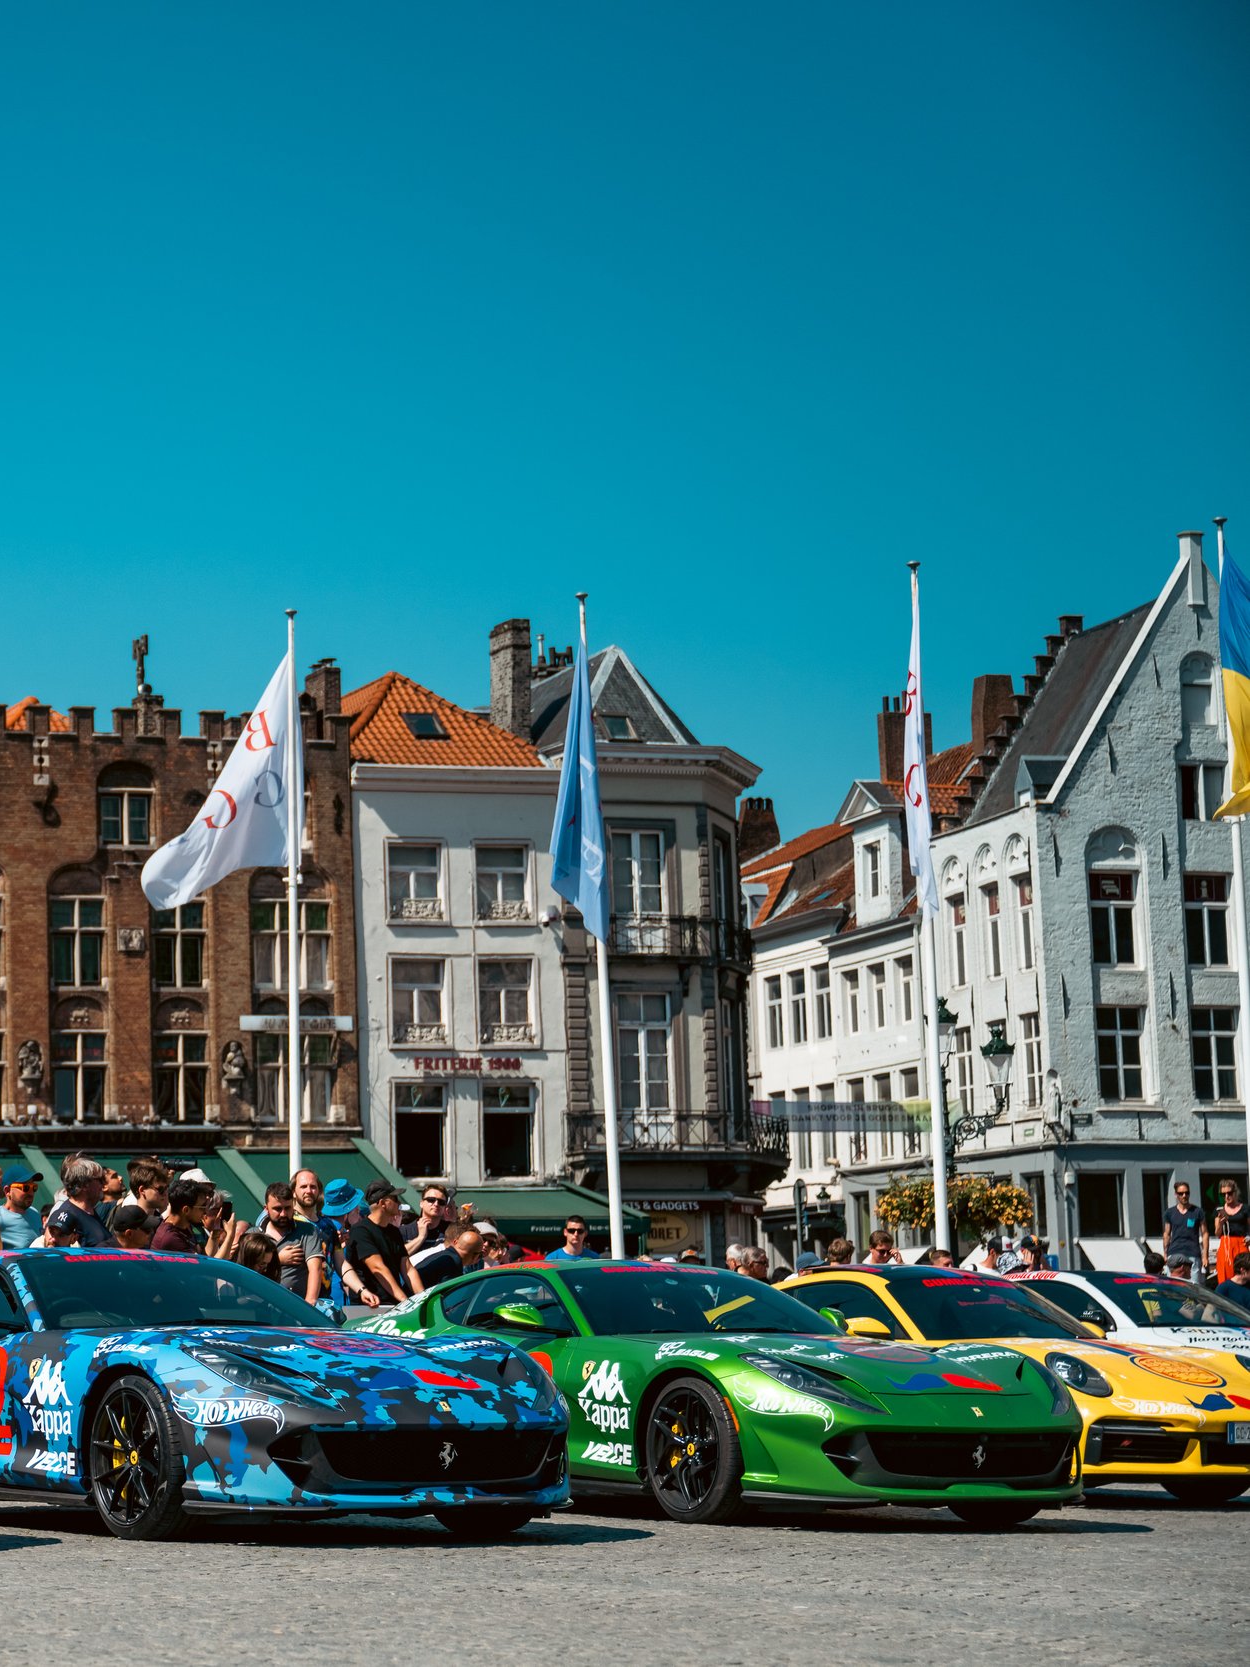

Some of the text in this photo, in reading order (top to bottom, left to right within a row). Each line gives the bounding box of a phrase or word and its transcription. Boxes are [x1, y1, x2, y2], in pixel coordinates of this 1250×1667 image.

[414, 1056, 483, 1071] FRITERIE
[653, 1201, 700, 1210] GADGETS
[23, 1404, 72, 1441] Kappa
[578, 1398, 630, 1434] Kappa
